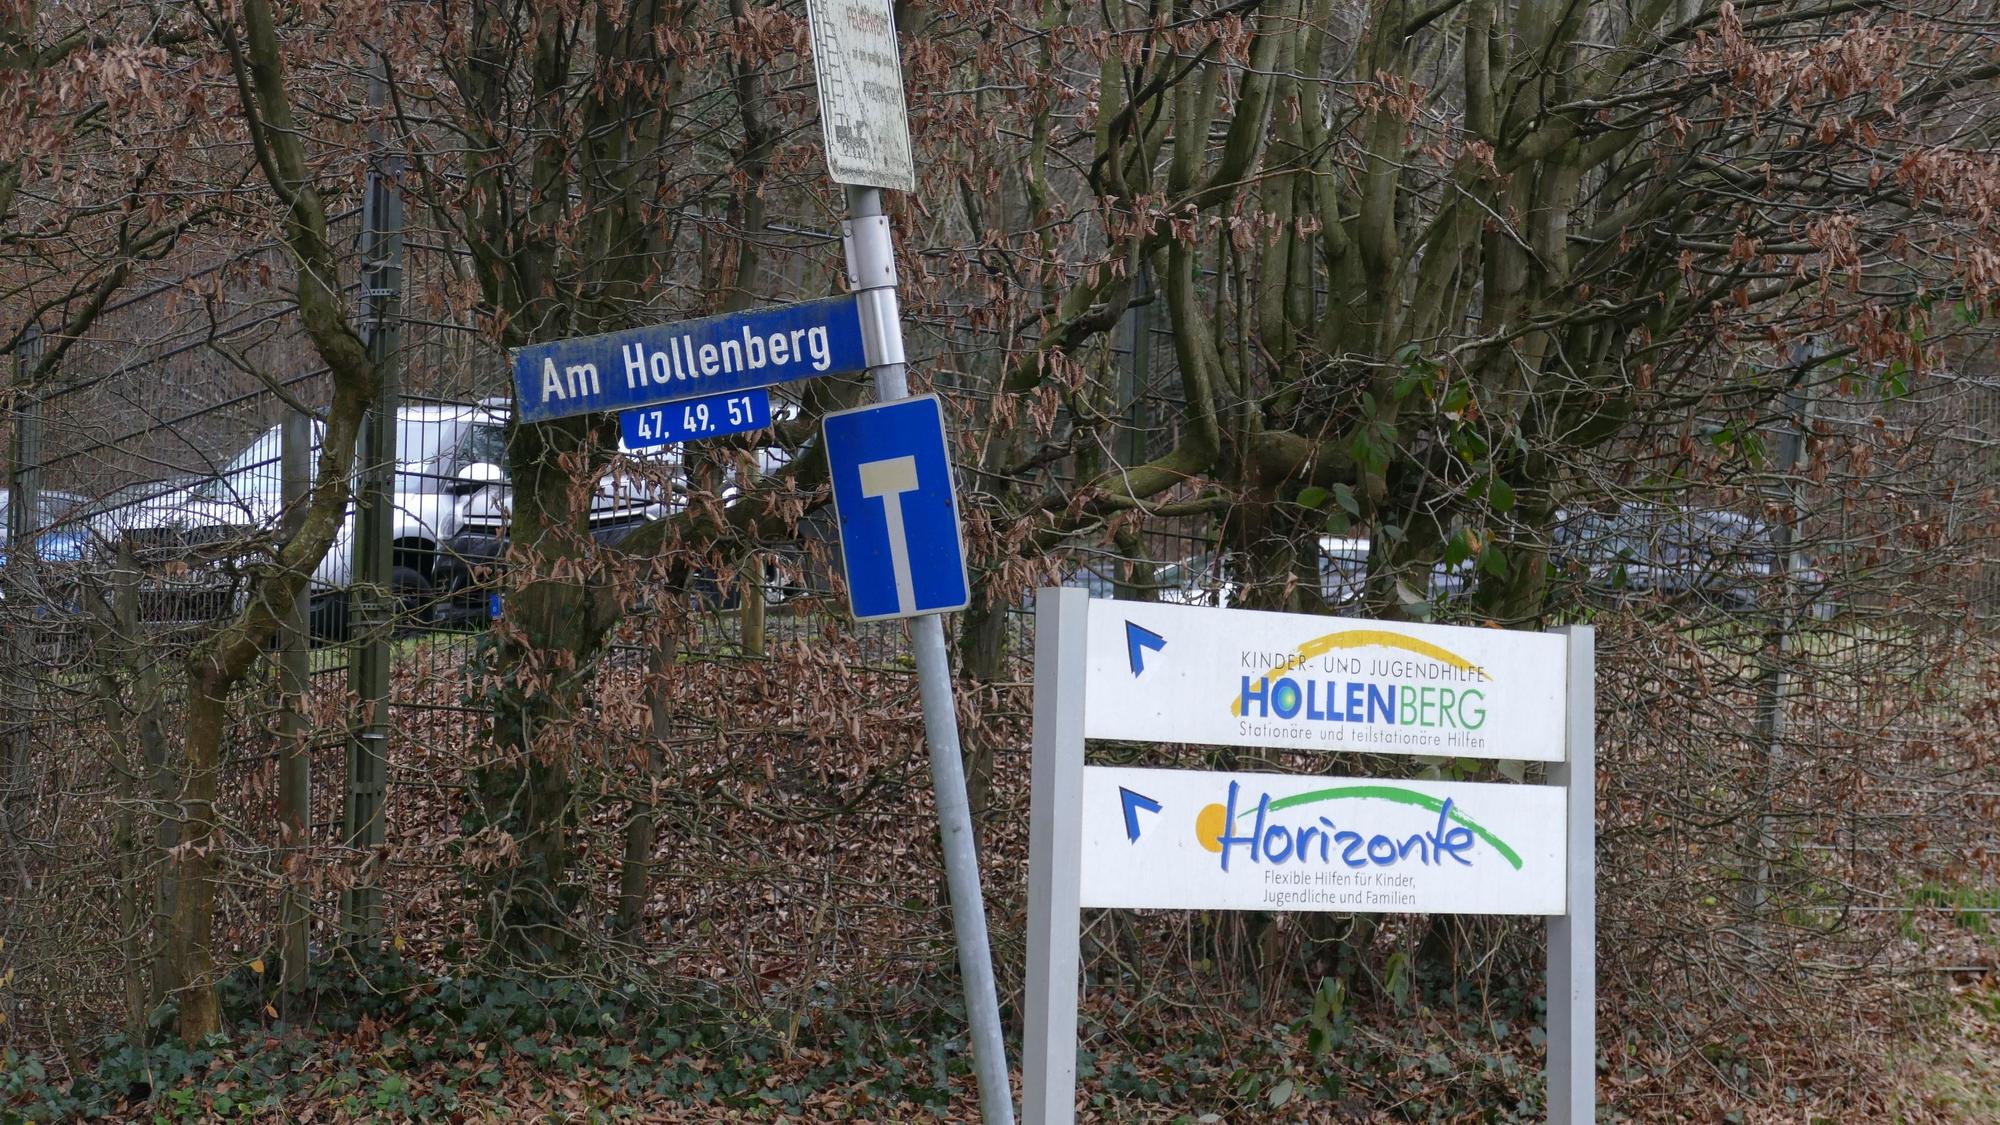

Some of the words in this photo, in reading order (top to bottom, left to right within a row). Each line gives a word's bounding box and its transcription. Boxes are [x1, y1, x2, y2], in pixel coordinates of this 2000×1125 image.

[542, 357, 600, 402] Am
[622, 325, 831, 389] Hollenberg
[638, 411, 669, 439] 47,
[683, 403, 715, 433] 49,
[728, 396, 753, 424] 51
[1241, 651, 1314, 672] KINDER-
[1324, 657, 1361, 675] UND
[1370, 659, 1485, 683] JUGENDHILFE
[1240, 675, 1487, 730] HOLLENBERG
[1239, 722, 1312, 740] Stationäre
[1320, 725, 1344, 742] und
[1352, 728, 1440, 746] teilstationäre
[1448, 731, 1485, 748] Hilfen
[1217, 779, 1475, 873] Horizonte
[1264, 889, 1336, 907] Jugendliche
[1340, 889, 1362, 904] und
[1366, 889, 1416, 905] Familien
[1265, 870, 1311, 885] Flexible
[1315, 871, 1351, 886] Hilfen
[1355, 872, 1374, 887] für
[1376, 873, 1416, 889] Kinder,
